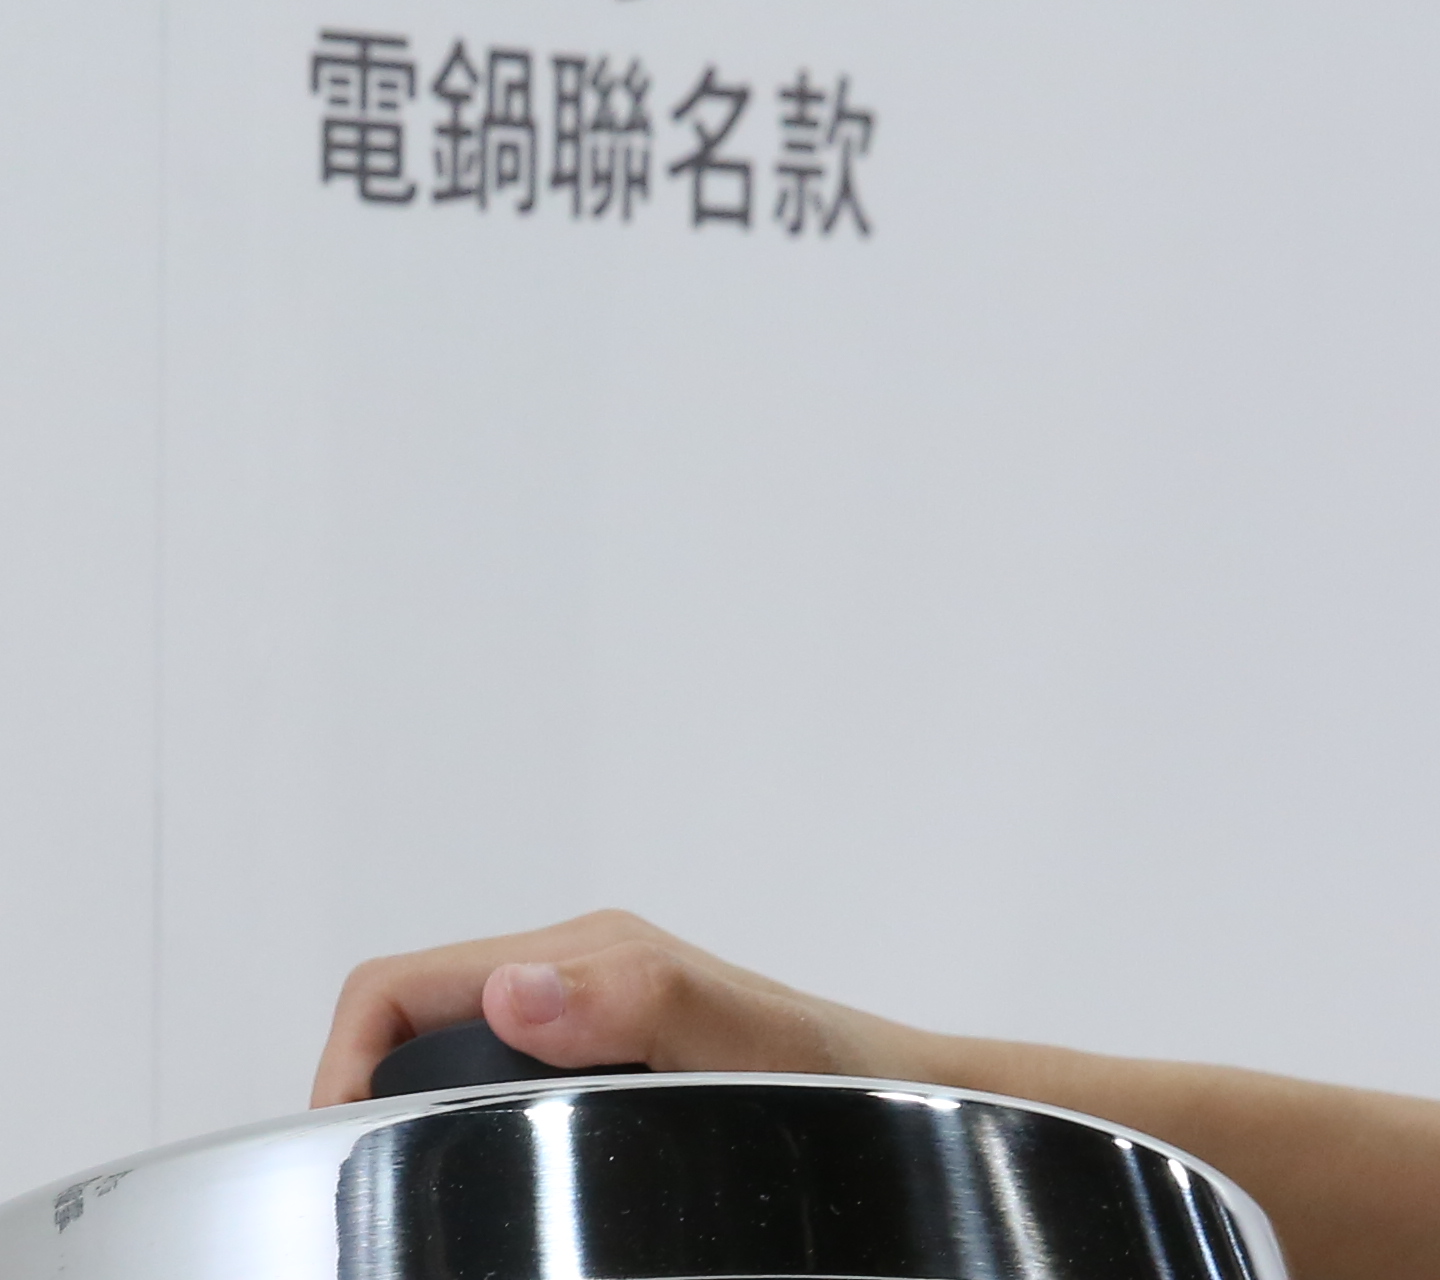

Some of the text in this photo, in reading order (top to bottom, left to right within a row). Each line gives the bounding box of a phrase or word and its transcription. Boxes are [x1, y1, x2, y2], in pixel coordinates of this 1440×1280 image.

[309, 28, 876, 240] 電鍋聯名款
